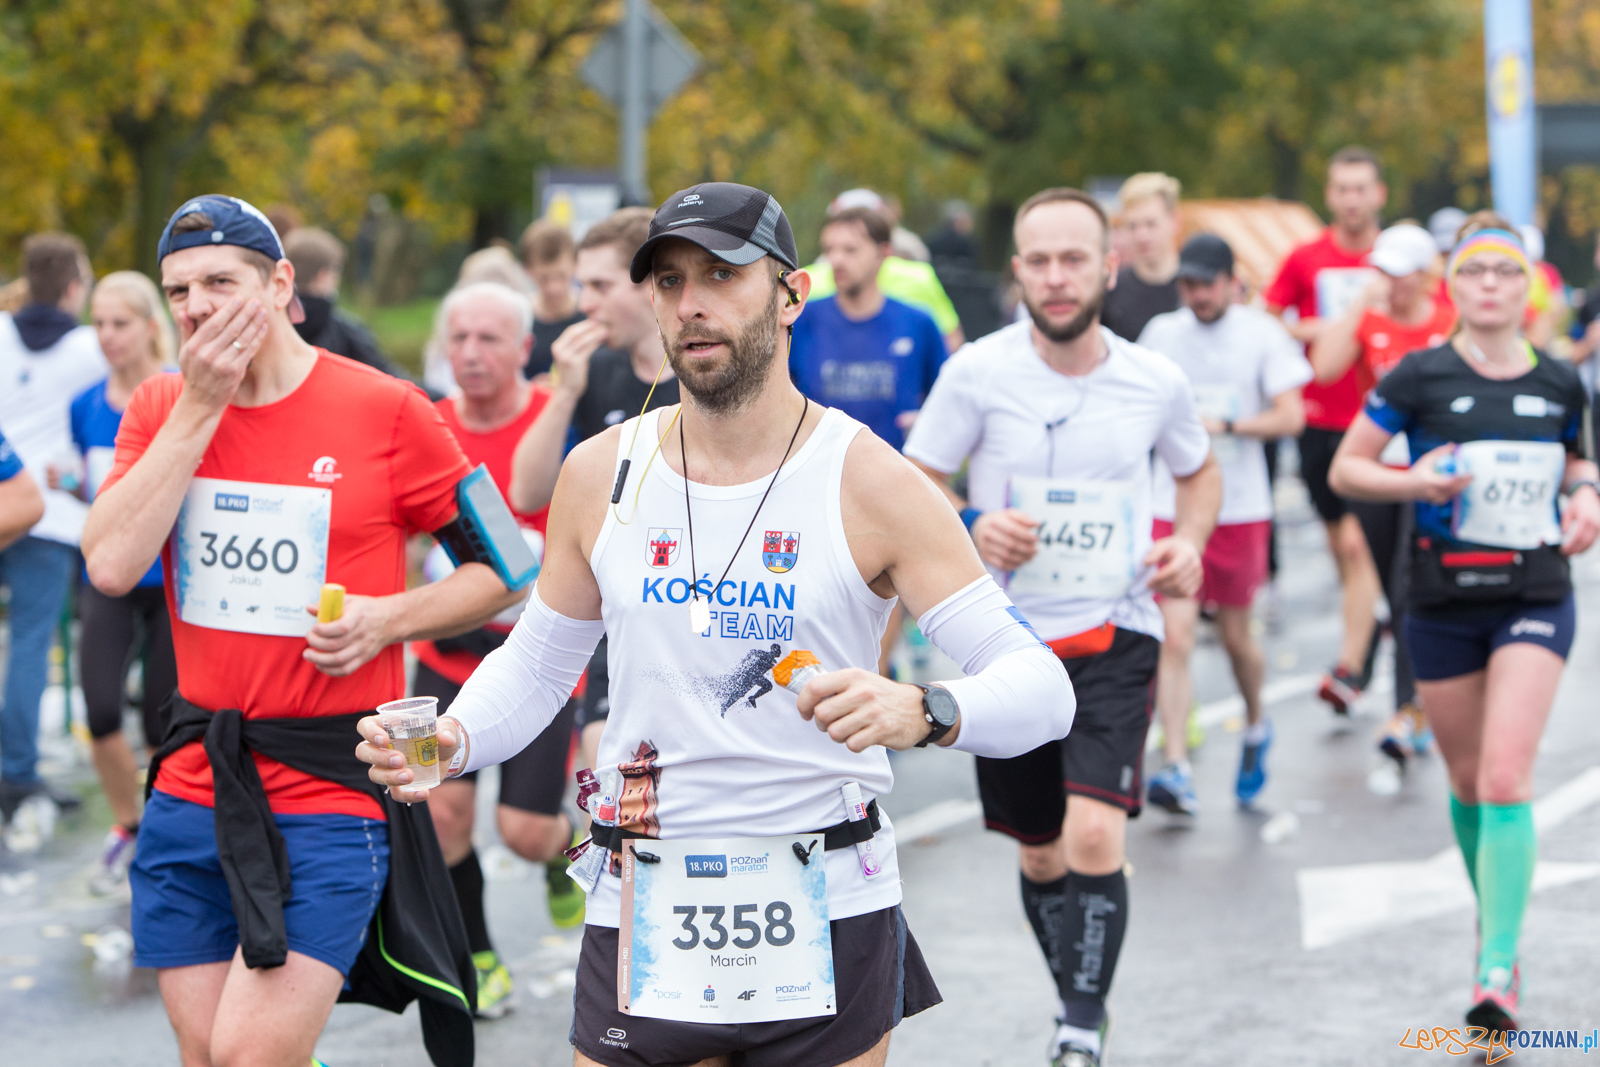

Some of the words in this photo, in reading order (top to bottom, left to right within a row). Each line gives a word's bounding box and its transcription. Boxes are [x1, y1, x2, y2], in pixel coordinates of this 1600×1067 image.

[1036, 521, 1114, 549] 4457
[200, 532, 299, 574] 3660
[228, 574, 262, 587] Jakub
[642, 573, 796, 611] KOŚCIAN
[702, 610, 794, 641] TEAM
[689, 860, 723, 872] 18.PKO
[731, 863, 768, 873] maraton
[672, 900, 795, 950] 3358
[710, 953, 757, 967] Marcin
[599, 1036, 630, 1049] Kalenji
